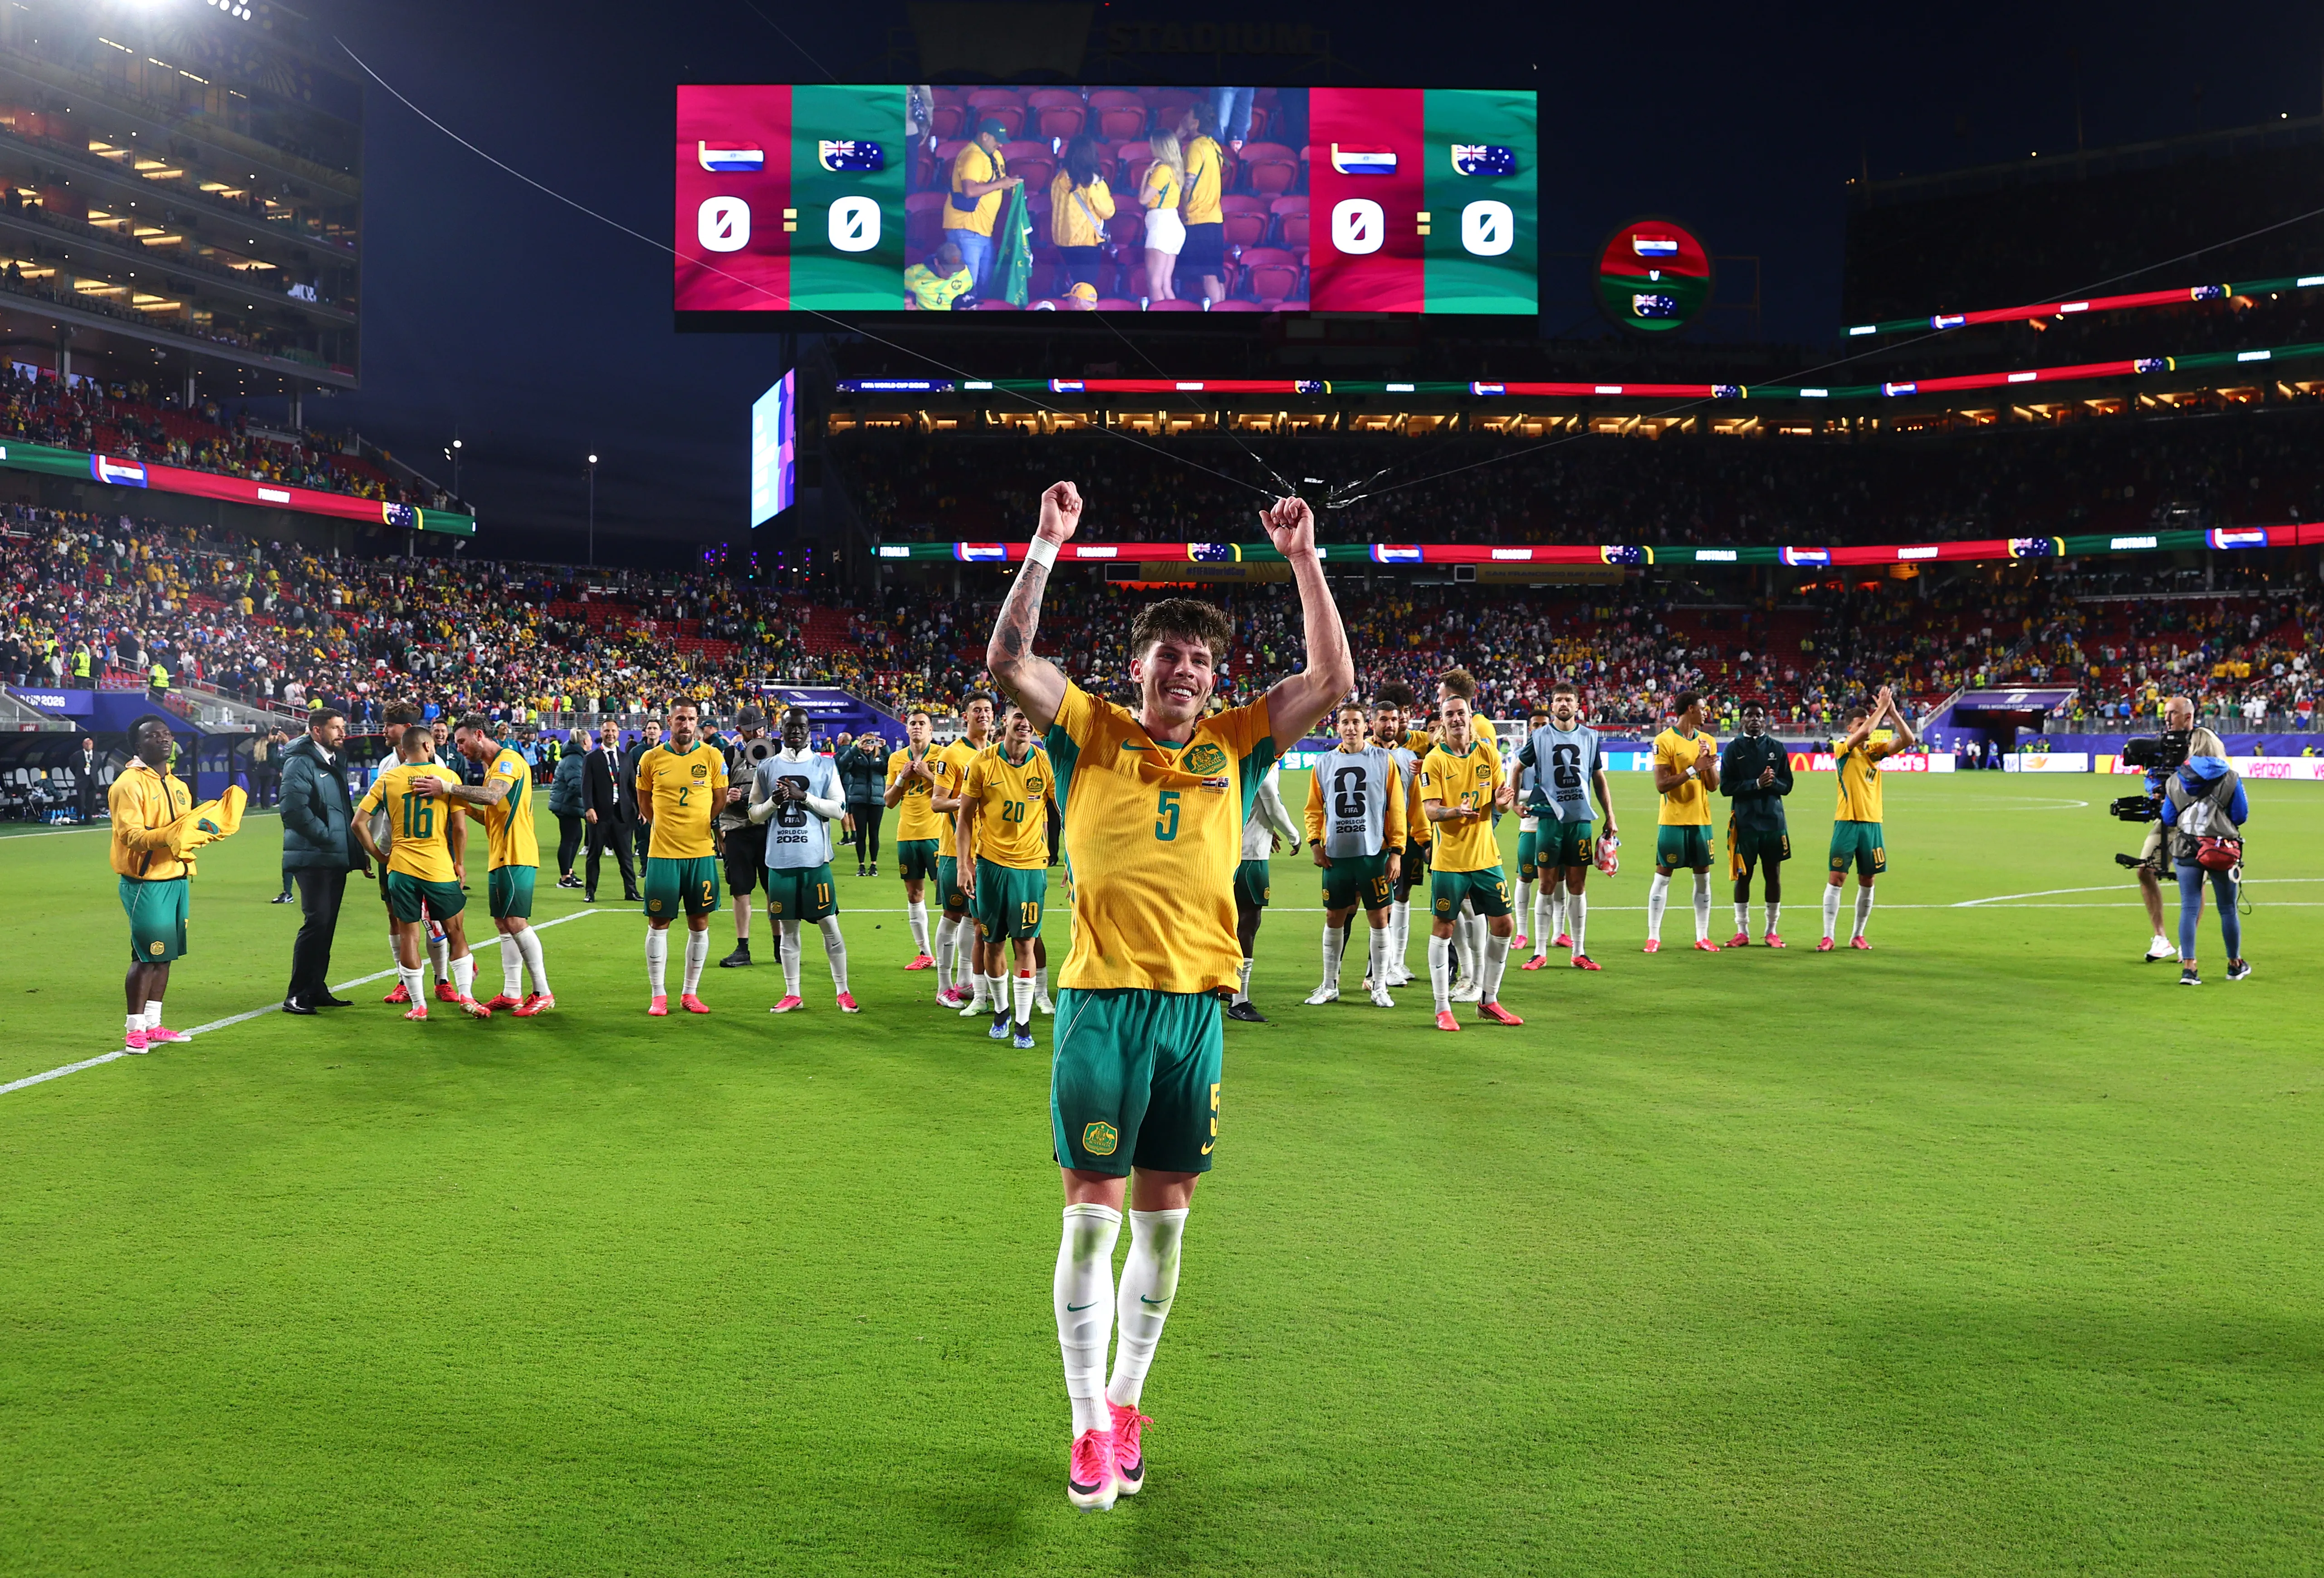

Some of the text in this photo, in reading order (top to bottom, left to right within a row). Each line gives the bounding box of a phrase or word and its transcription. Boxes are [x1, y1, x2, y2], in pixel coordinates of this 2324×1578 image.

[1106, 21, 1313, 54] STADIUM
[1186, 567, 1246, 577] #FIFAWorldCup
[41, 696, 66, 707] 2026
[1198, 758, 1222, 772] AUSTRALIA
[2248, 757, 2291, 779] verizon
[680, 786, 688, 806] 2
[401, 792, 434, 838] 16
[1002, 800, 1025, 823] 20
[1155, 790, 1180, 841] 5
[1336, 825, 1366, 833] 2026
[1872, 847, 1886, 864] 10
[702, 880, 713, 901] 2
[817, 883, 830, 903] 11
[1371, 875, 1389, 897] 15
[1021, 902, 1038, 924] 20
[1089, 1140, 1111, 1148] AUSTRALIA
